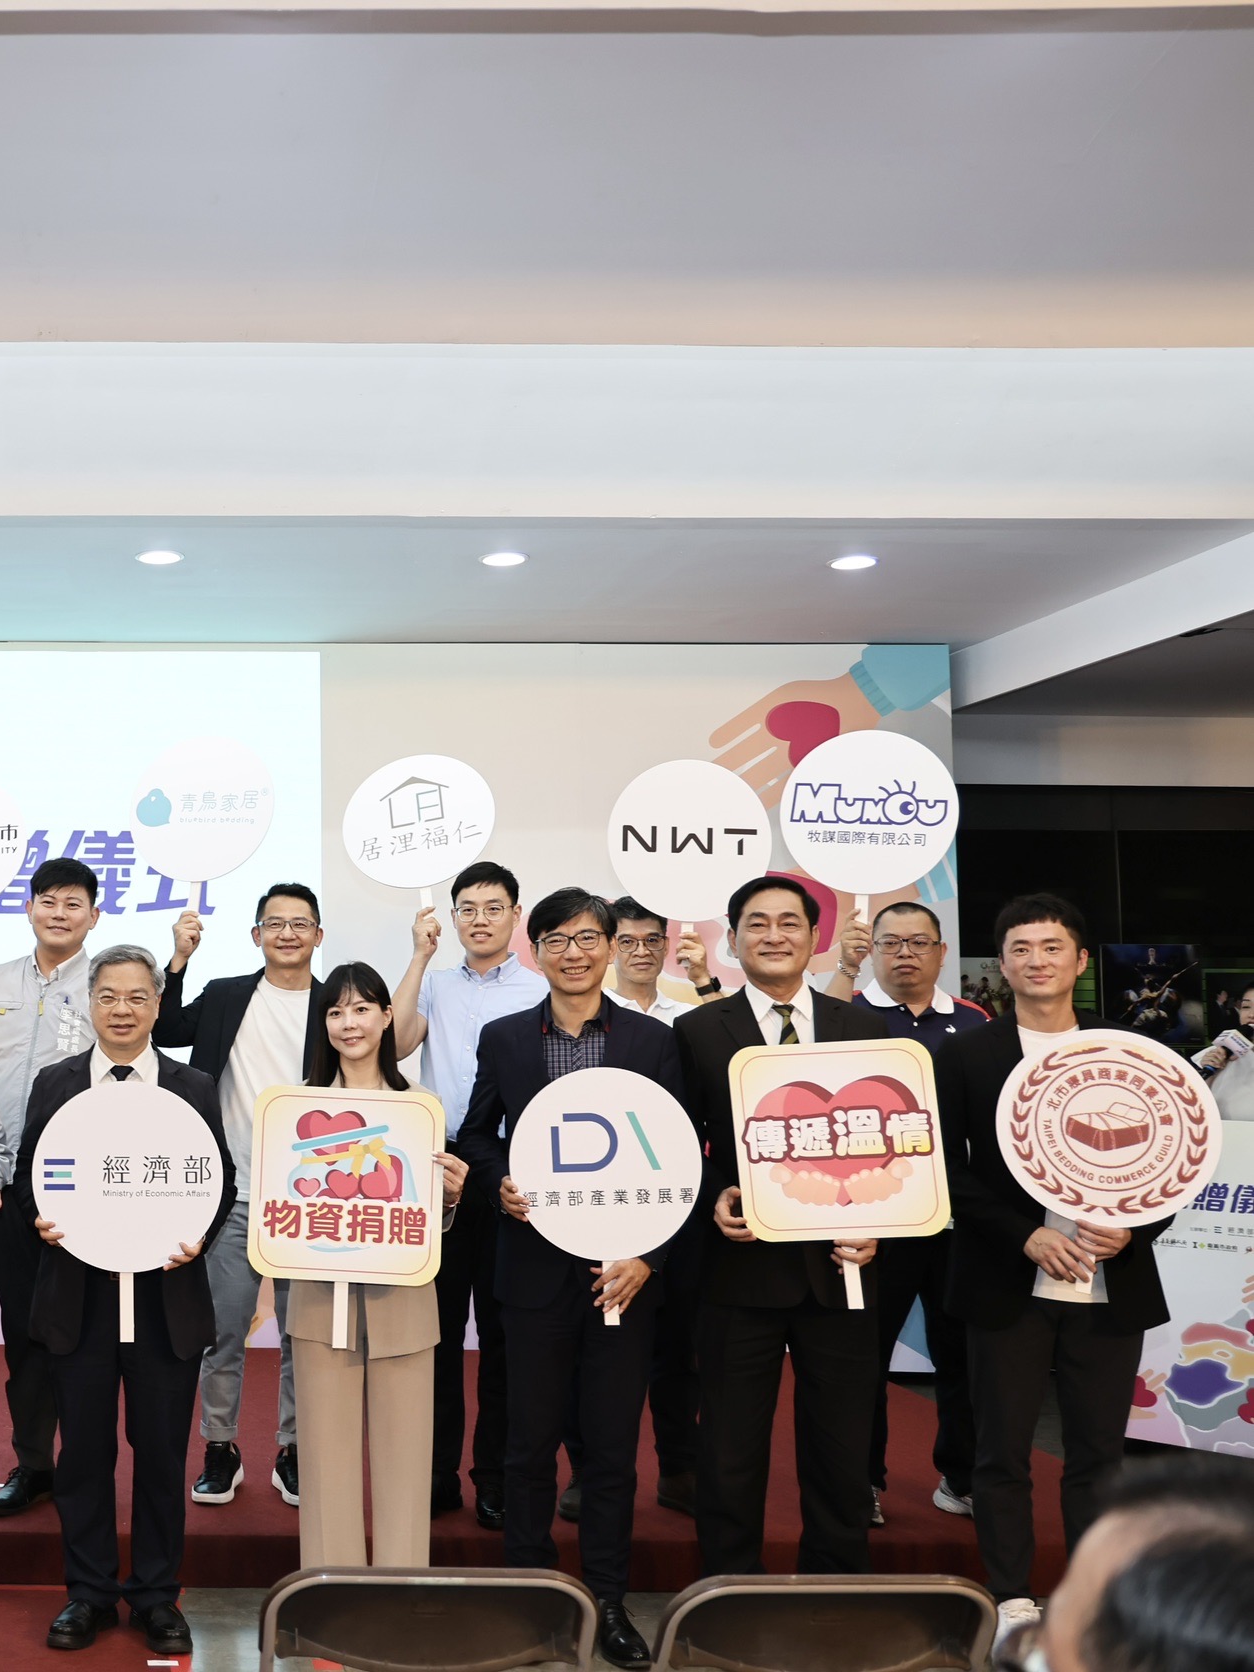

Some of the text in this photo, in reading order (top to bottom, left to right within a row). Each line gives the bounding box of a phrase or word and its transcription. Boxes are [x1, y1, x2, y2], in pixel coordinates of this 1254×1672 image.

[358, 821, 483, 861] 居浬福仁
[622, 825, 758, 856] NWT
[807, 830, 927, 847] 牧謀國際有限公司
[745, 1108, 932, 1161] 傳遞溫情
[1043, 1118, 1174, 1184] TAIPEI BEDDING COMMERCE GUILD
[102, 1155, 212, 1184] 經濟部
[102, 1189, 211, 1198] Ministry of Economic Affairs
[523, 1187, 695, 1208] 經濟部產業發展署
[1192, 1183, 1254, 1214] 贈儀
[263, 1200, 427, 1245] 物資捐贈
